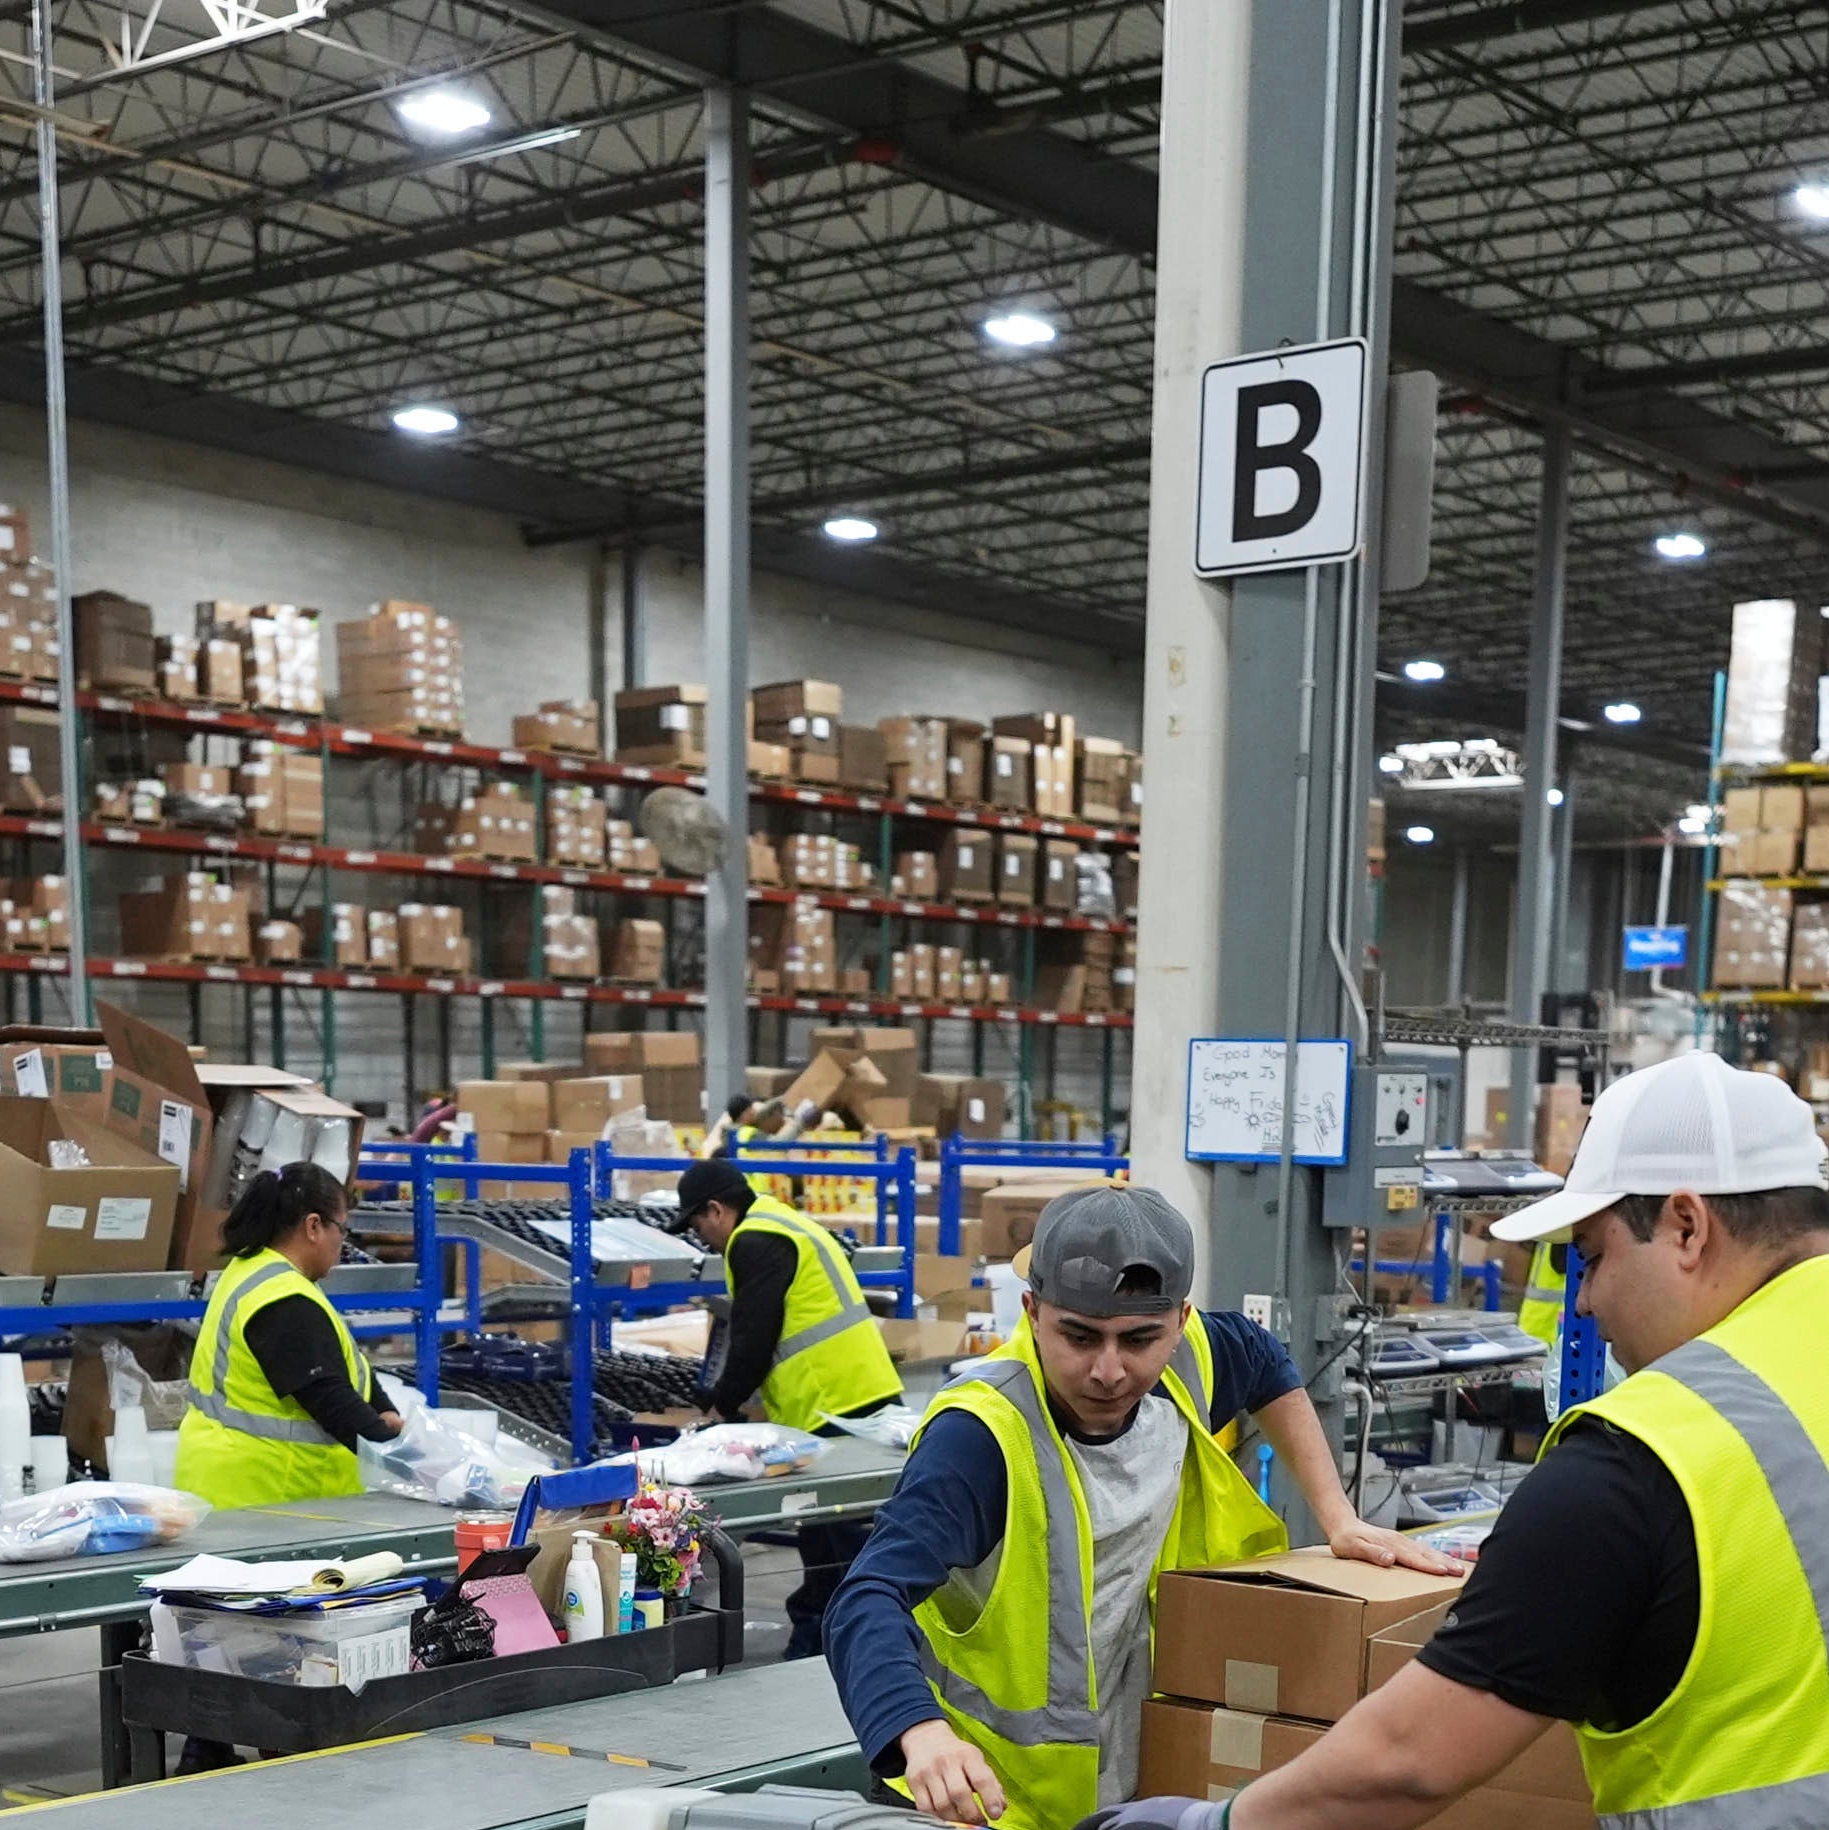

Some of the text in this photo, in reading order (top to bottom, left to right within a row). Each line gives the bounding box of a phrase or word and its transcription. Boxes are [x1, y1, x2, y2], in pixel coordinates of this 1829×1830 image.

[1232, 379, 1322, 543] B
[1202, 1066, 1250, 1088] Everyone
[1209, 1090, 1284, 1113] Happy Frida
